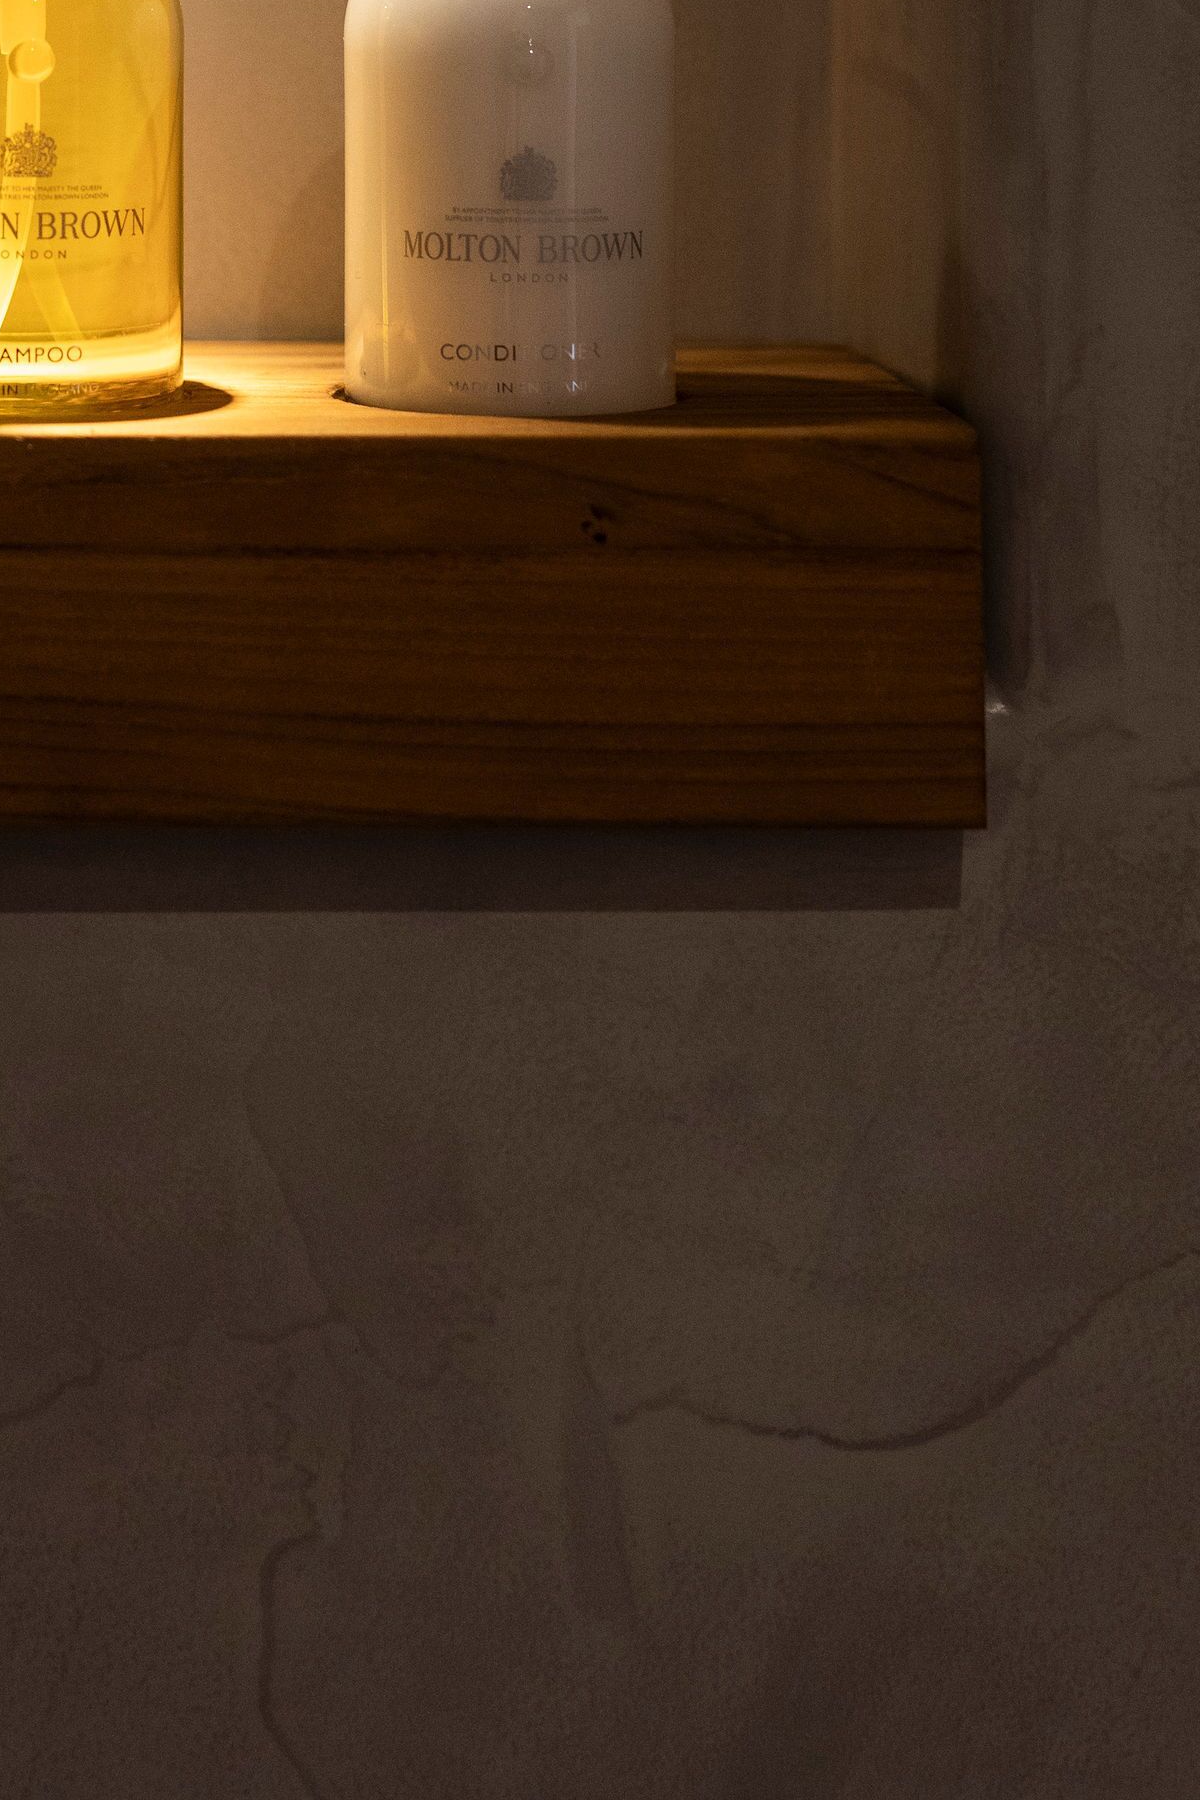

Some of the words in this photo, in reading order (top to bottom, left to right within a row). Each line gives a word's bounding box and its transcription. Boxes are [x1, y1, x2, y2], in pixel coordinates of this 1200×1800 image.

[37, 208, 146, 240] BROWN
[404, 231, 520, 263] MOLTON
[538, 231, 643, 263] BROWN
[490, 272, 569, 283] LONDON
[440, 343, 601, 362] CONDIONER
[1, 383, 18, 396] IN
[449, 380, 488, 393] MAD
[497, 382, 513, 393] IN
